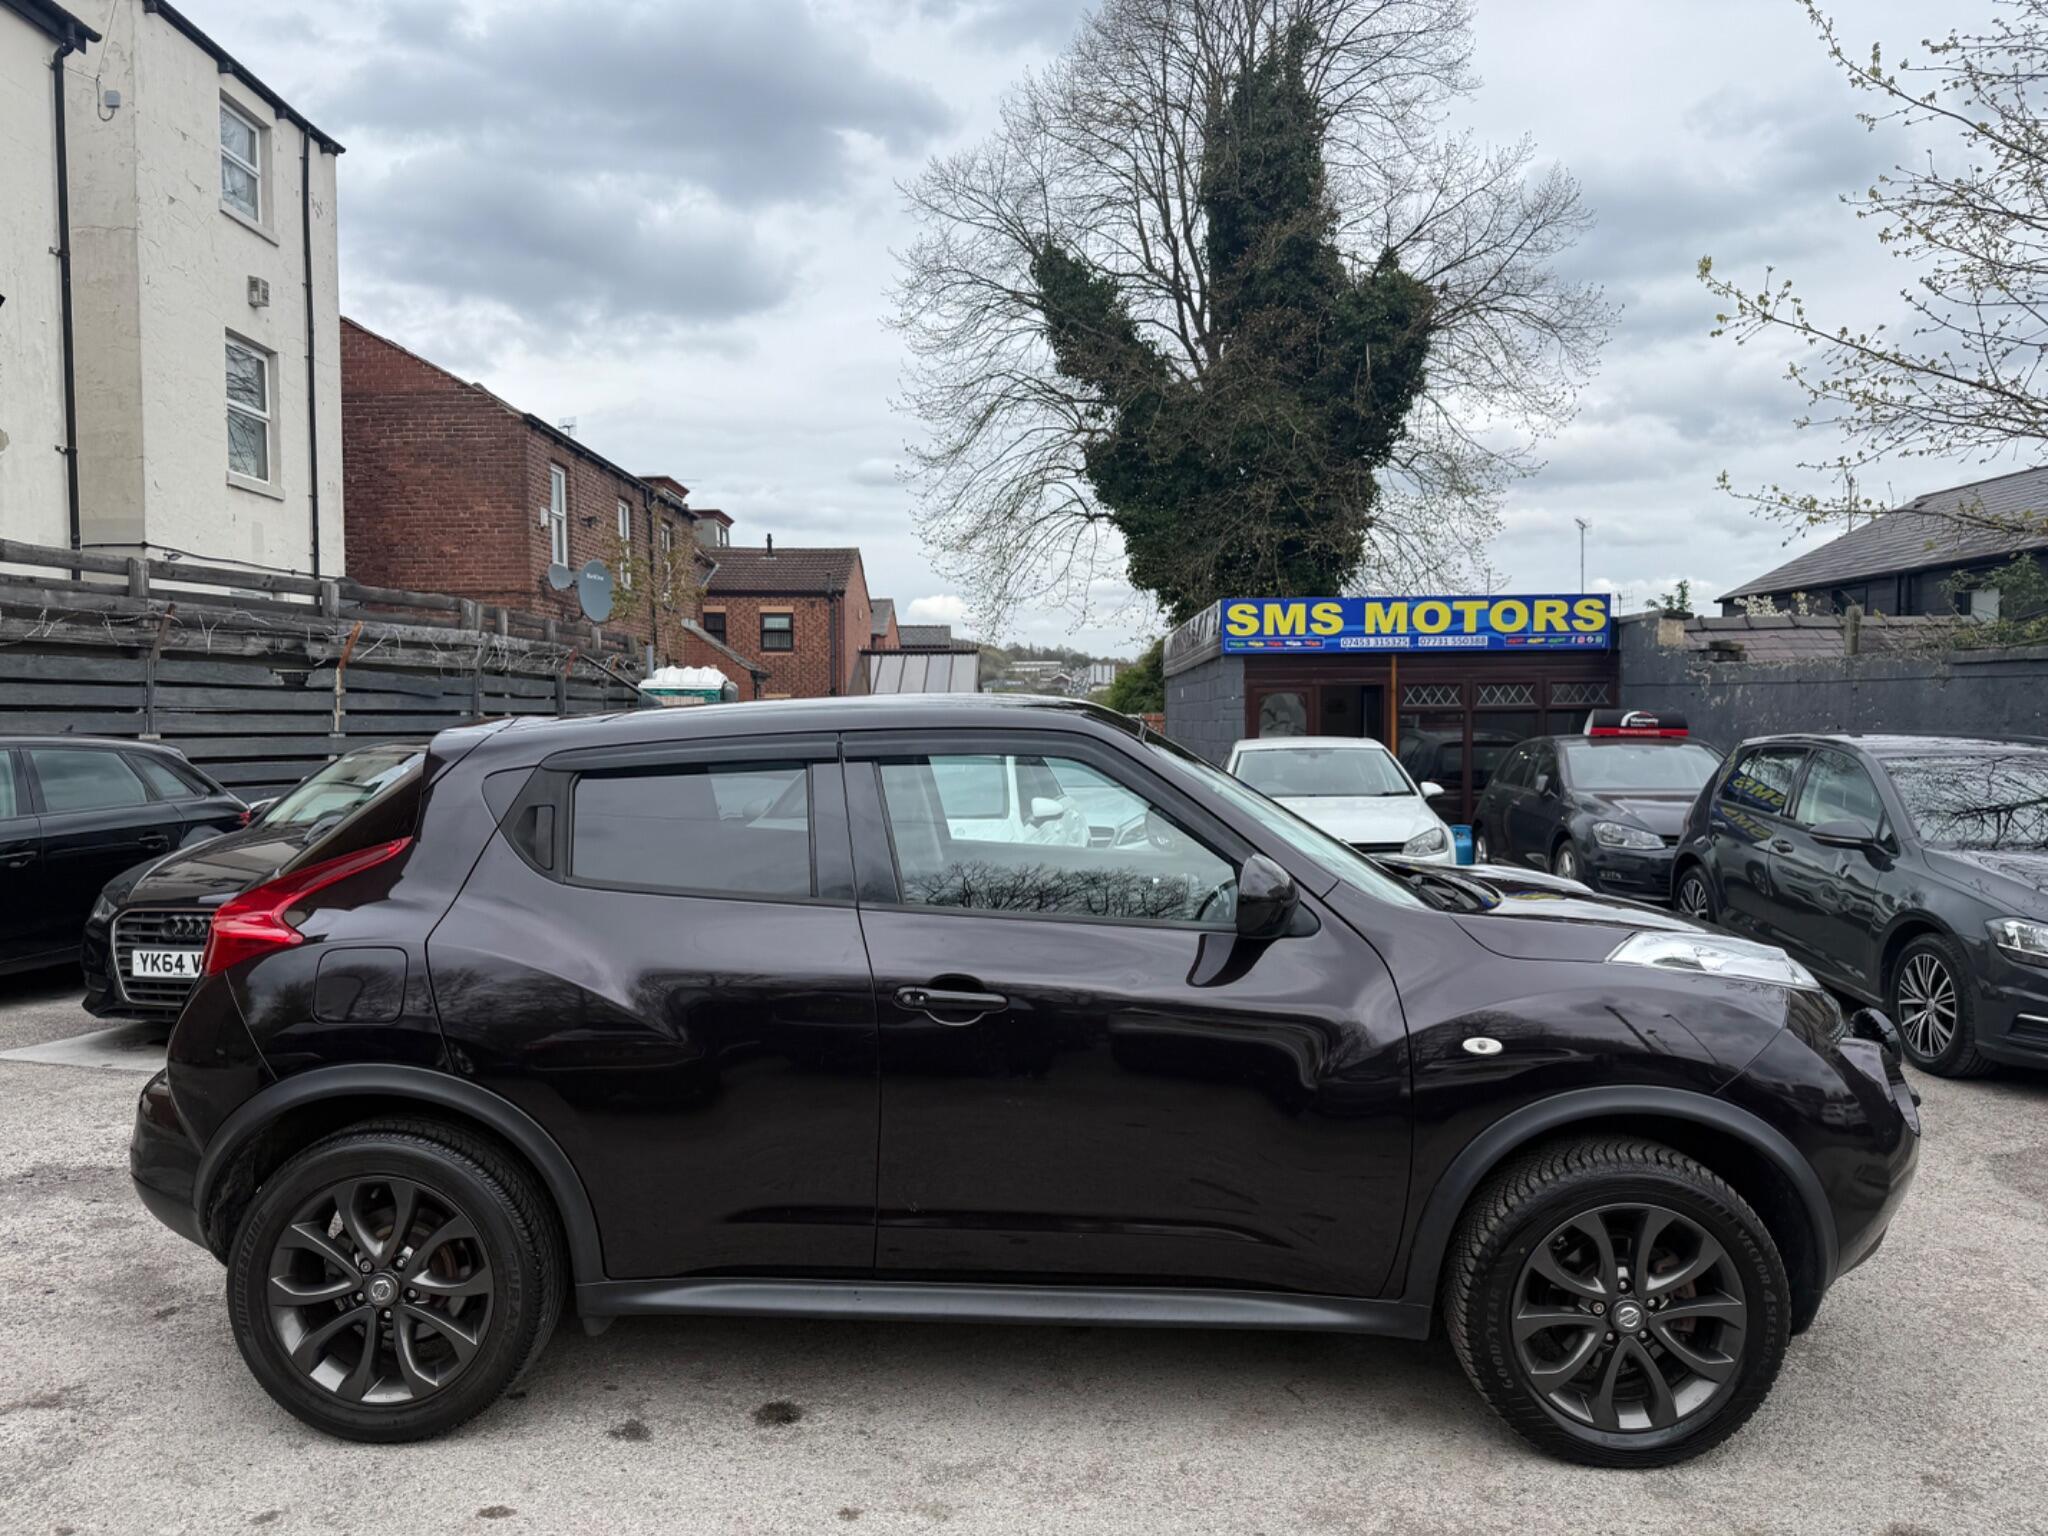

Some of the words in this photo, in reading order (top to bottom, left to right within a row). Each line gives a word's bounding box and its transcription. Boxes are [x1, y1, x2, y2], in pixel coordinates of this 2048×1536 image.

[1226, 602, 1345, 637] SMS
[1364, 599, 1607, 635] MOTORS
[140, 953, 186, 973] YK64
[1736, 1229, 1772, 1286] VECTOR
[1485, 1286, 1516, 1390] GOODYEAR
